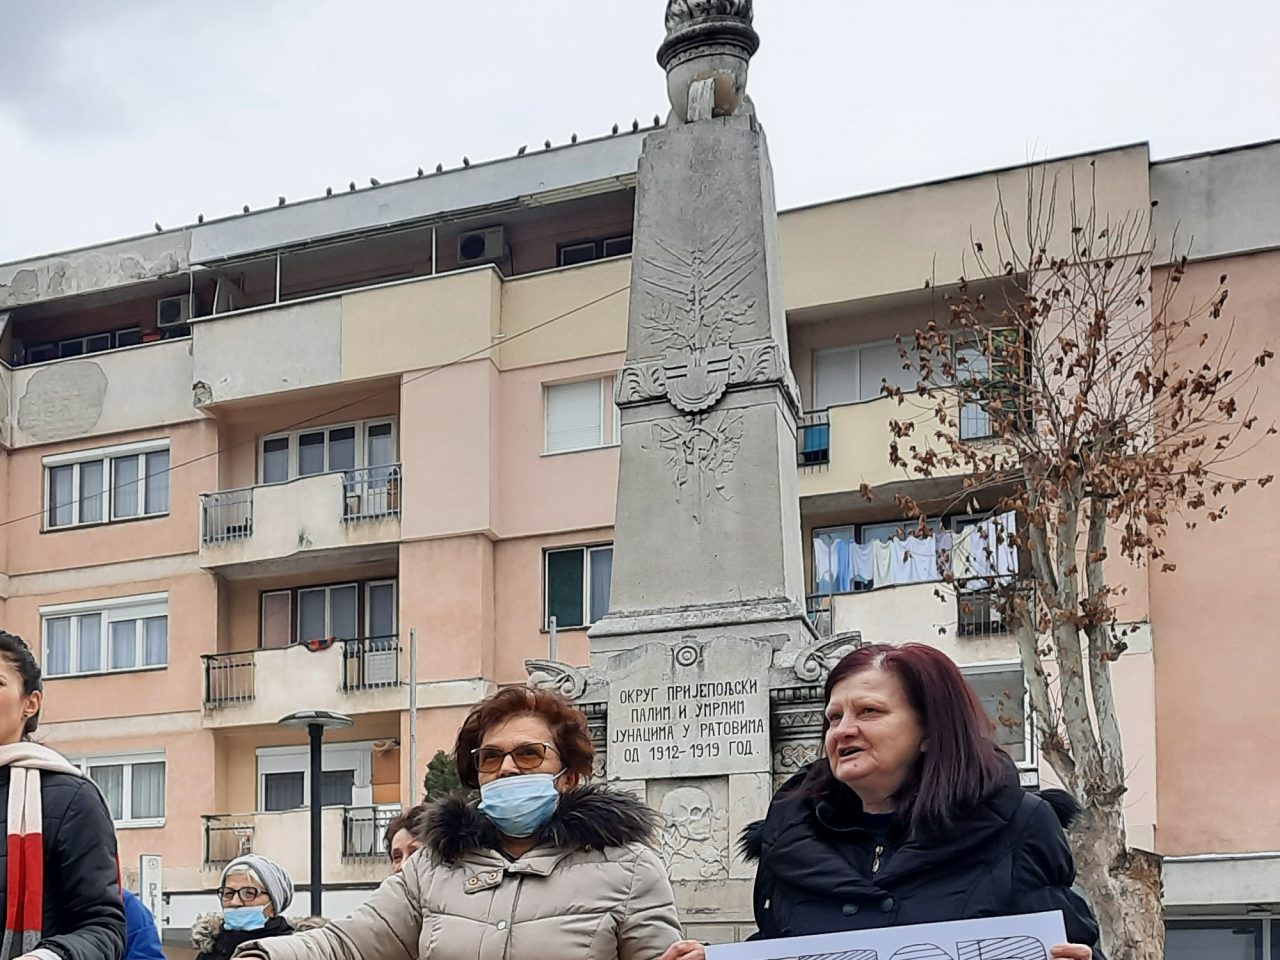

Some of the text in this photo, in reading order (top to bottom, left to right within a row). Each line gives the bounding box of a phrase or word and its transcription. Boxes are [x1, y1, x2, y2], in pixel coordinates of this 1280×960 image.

[619, 679, 758, 704] ОКРУГ ПРИЈЕПОЉСКИ
[631, 700, 745, 723] ПАЛИМ И УМРЛИМ
[612, 718, 764, 744] ЈУНАЦИМА У РАТОВИМА
[624, 748, 640, 763] ОД
[729, 740, 760, 756] ГОД.
